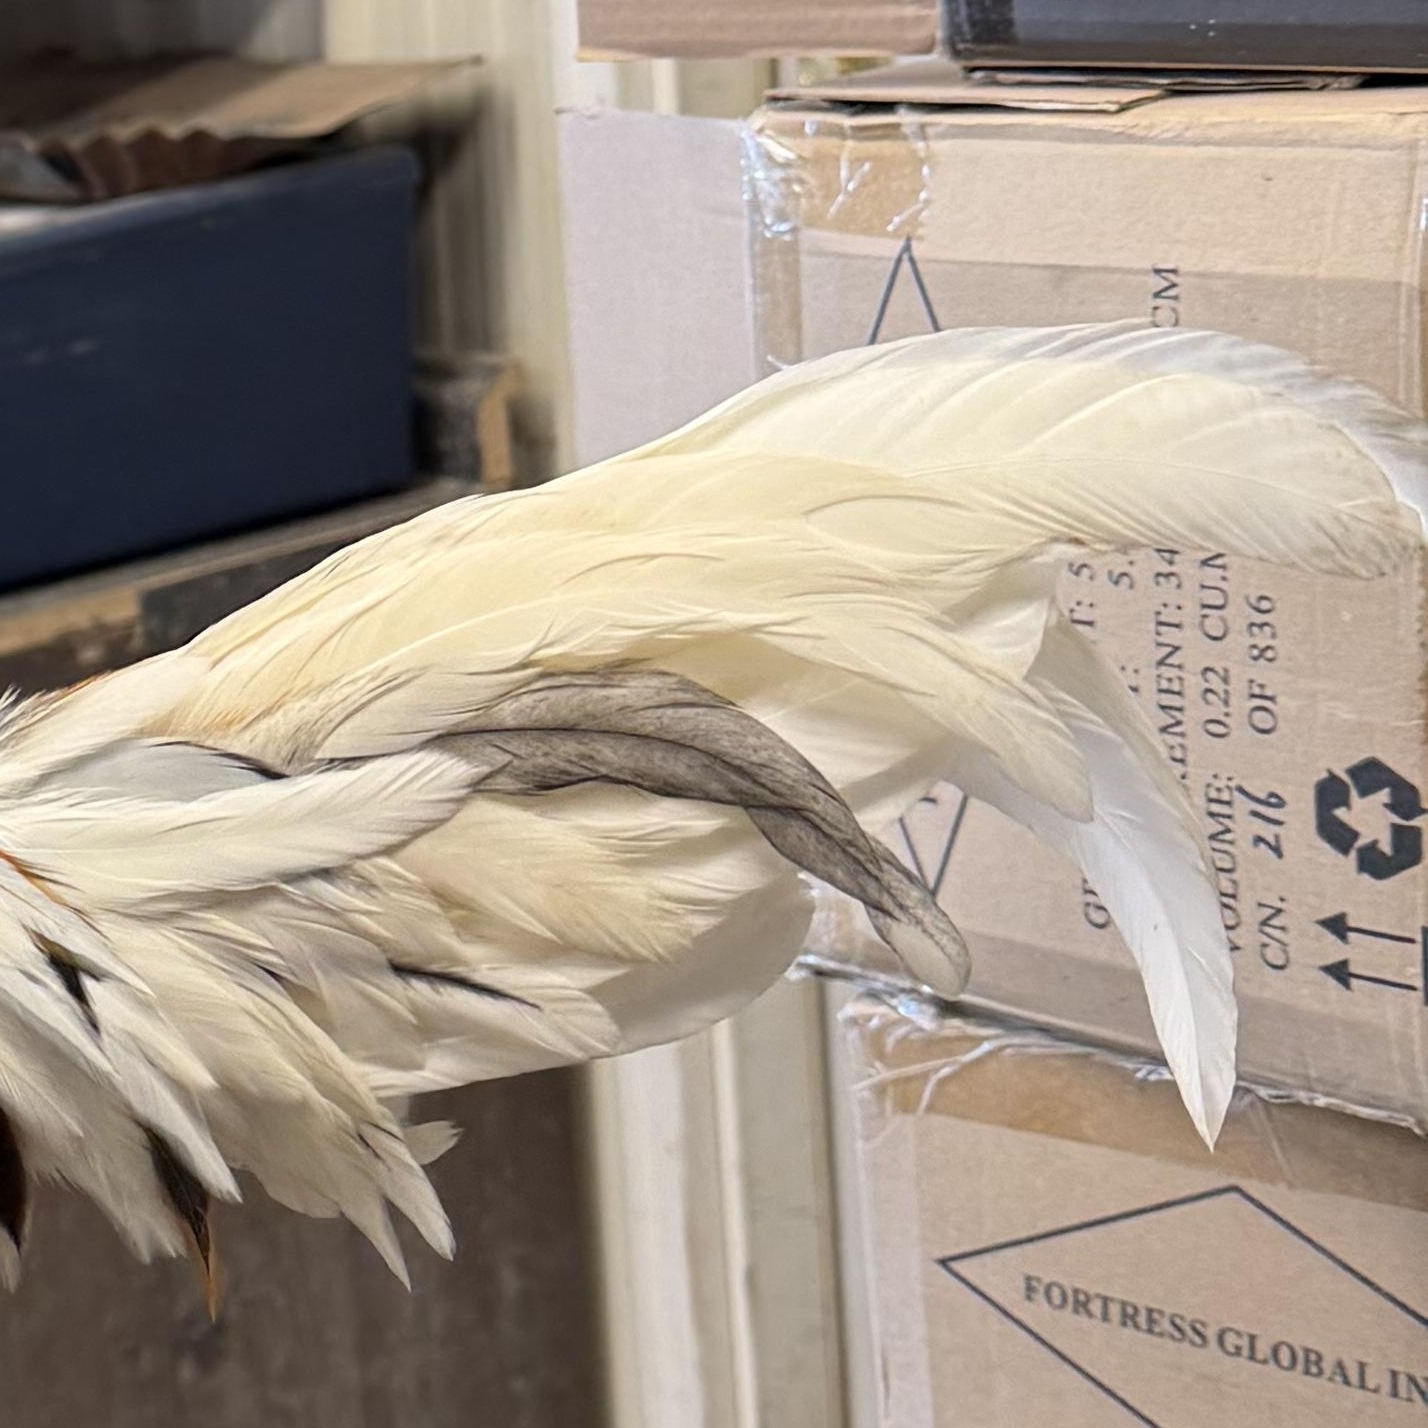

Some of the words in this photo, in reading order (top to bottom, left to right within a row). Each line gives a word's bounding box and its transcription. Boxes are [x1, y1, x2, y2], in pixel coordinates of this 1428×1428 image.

[1246, 594, 1278, 663] 836
[1201, 666, 1232, 739] 0.22
[1247, 679, 1278, 735] OF
[1257, 896, 1291, 971] C/N.
[1023, 1274, 1209, 1349] FORTRESS
[1217, 1326, 1380, 1395] GLOBAL
